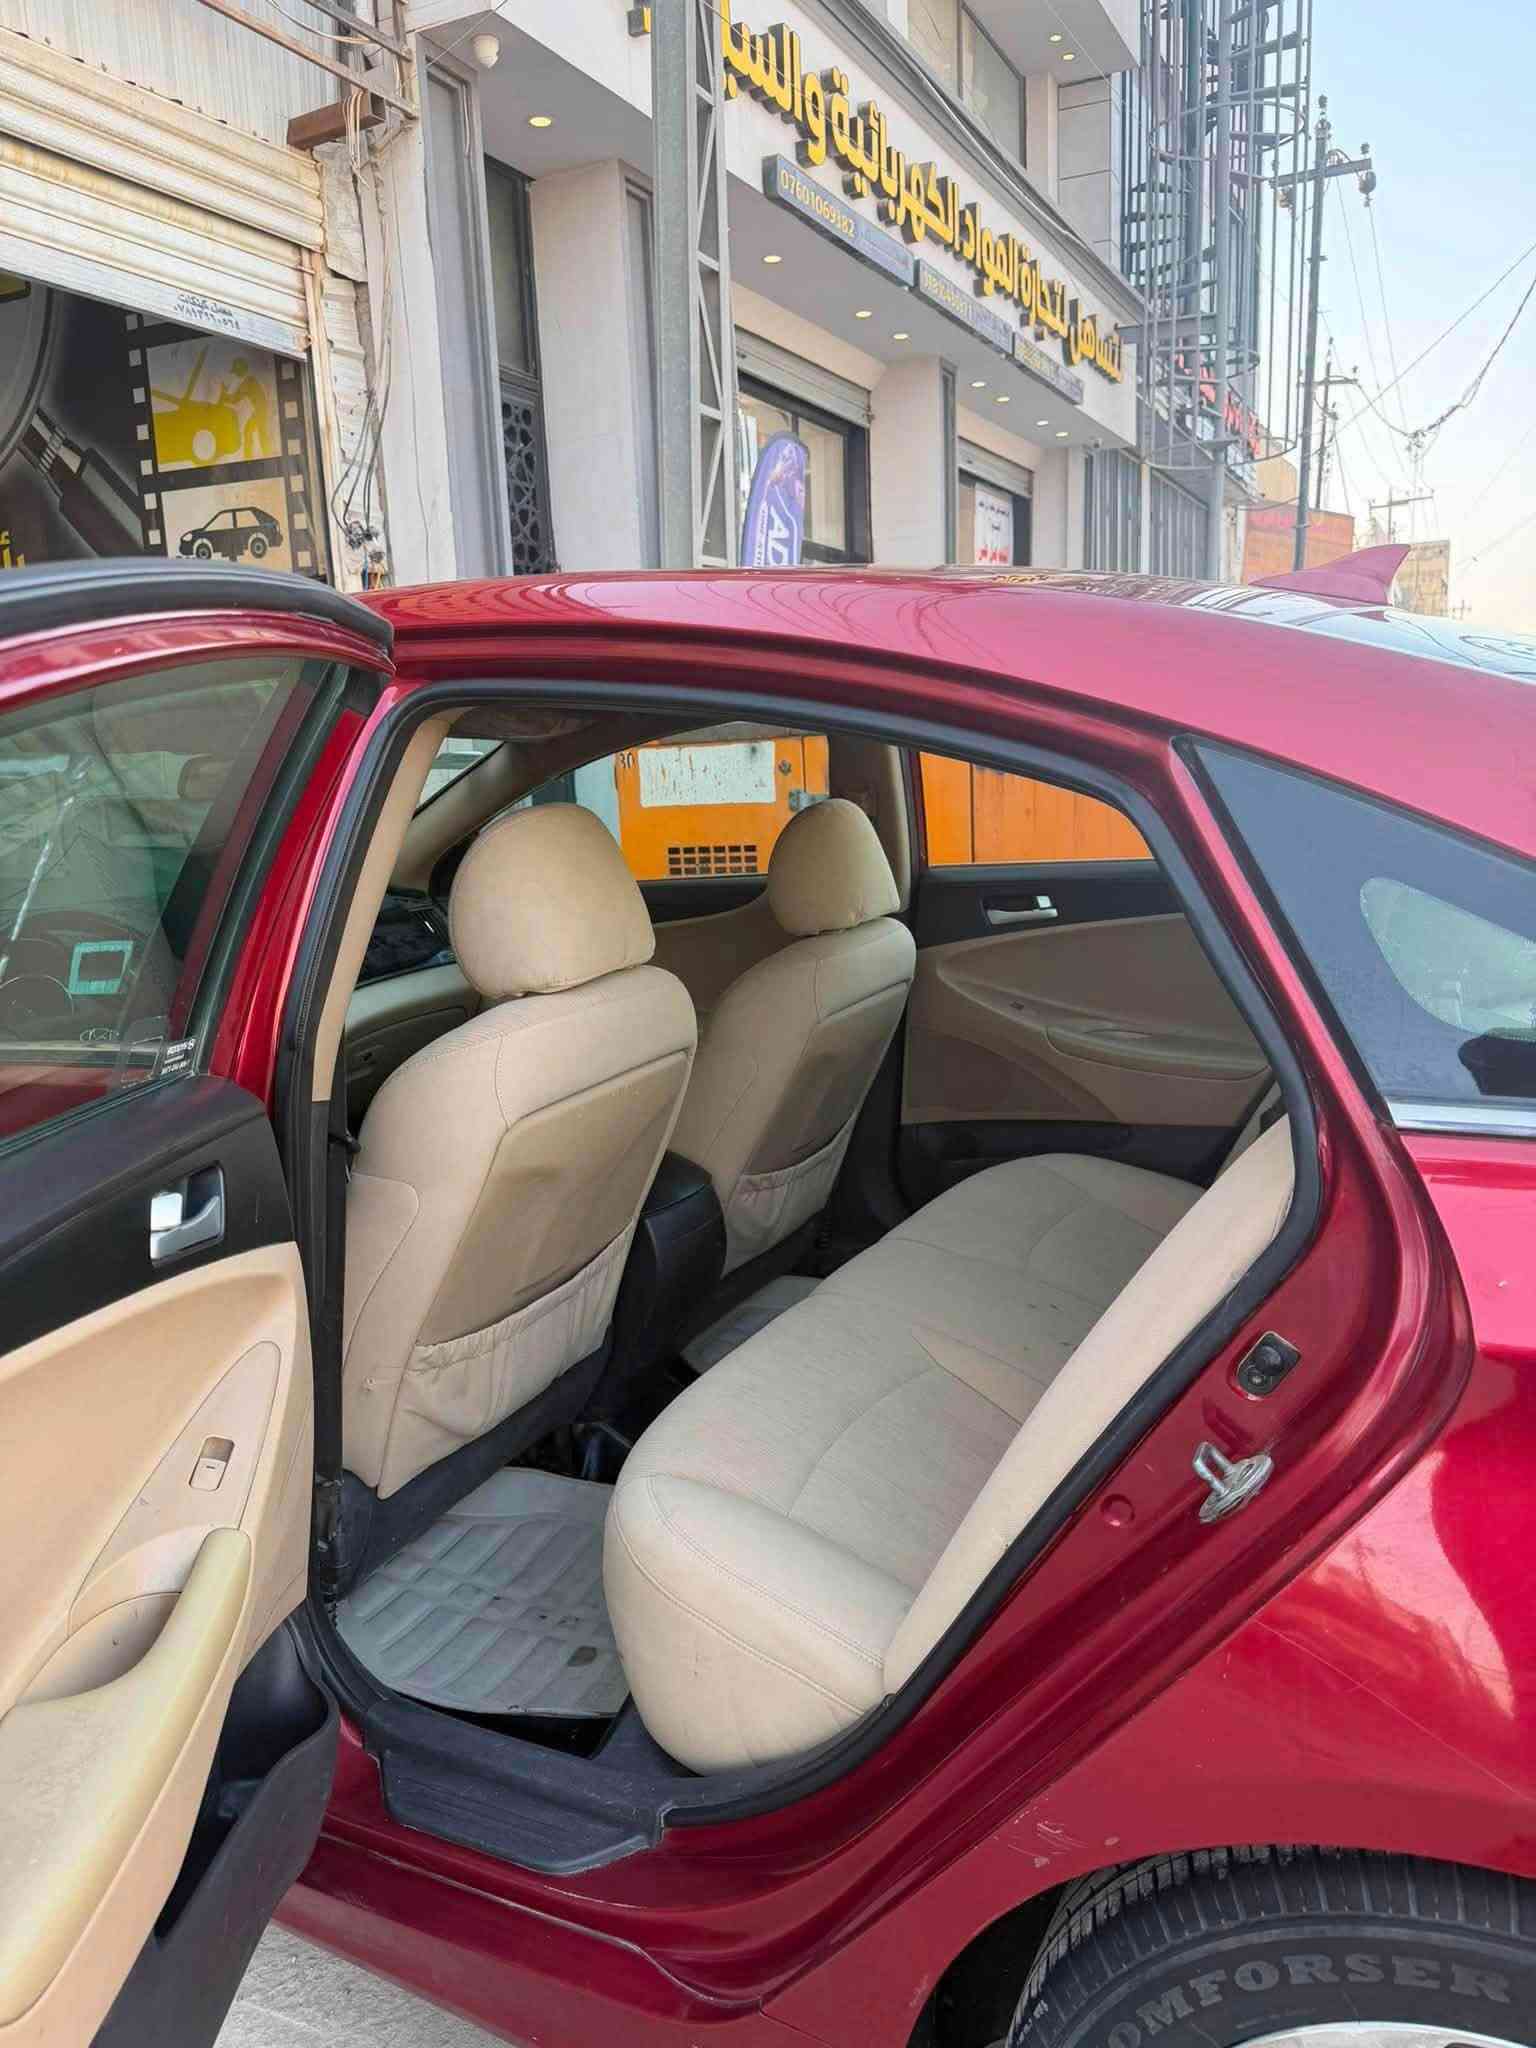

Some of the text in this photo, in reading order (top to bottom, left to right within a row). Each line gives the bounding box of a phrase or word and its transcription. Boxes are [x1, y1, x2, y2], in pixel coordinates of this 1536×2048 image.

[831, 65, 960, 253] الكهربائية
[963, 202, 1020, 297] المواد
[1106, 1953, 1512, 2048] OMFORSER
